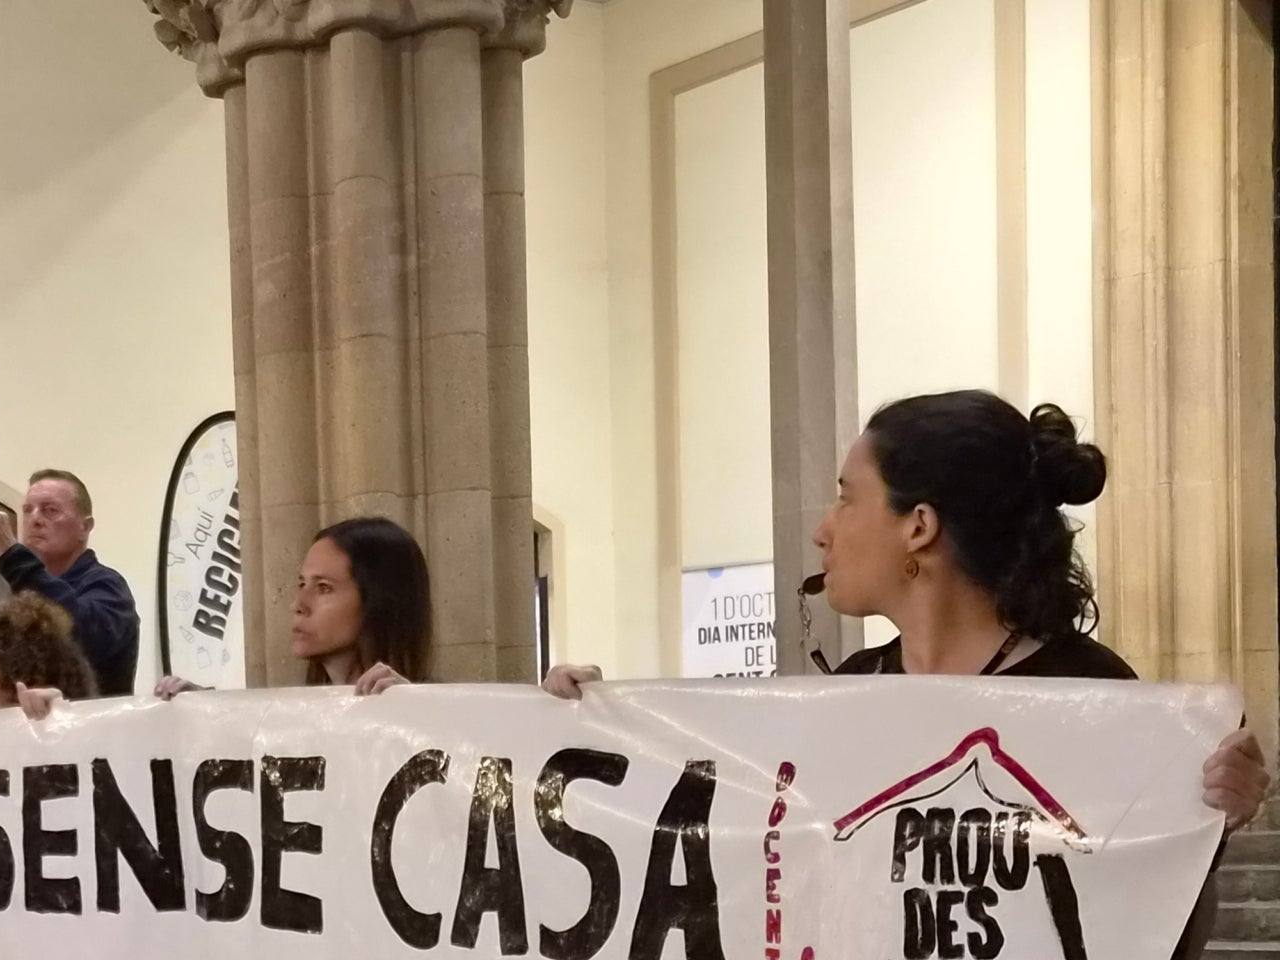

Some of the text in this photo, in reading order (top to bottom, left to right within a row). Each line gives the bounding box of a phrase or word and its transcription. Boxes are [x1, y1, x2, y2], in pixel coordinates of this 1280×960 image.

[698, 625, 722, 646] DIA
[745, 645, 765, 668] DE
[890, 806, 1033, 891] PROU
